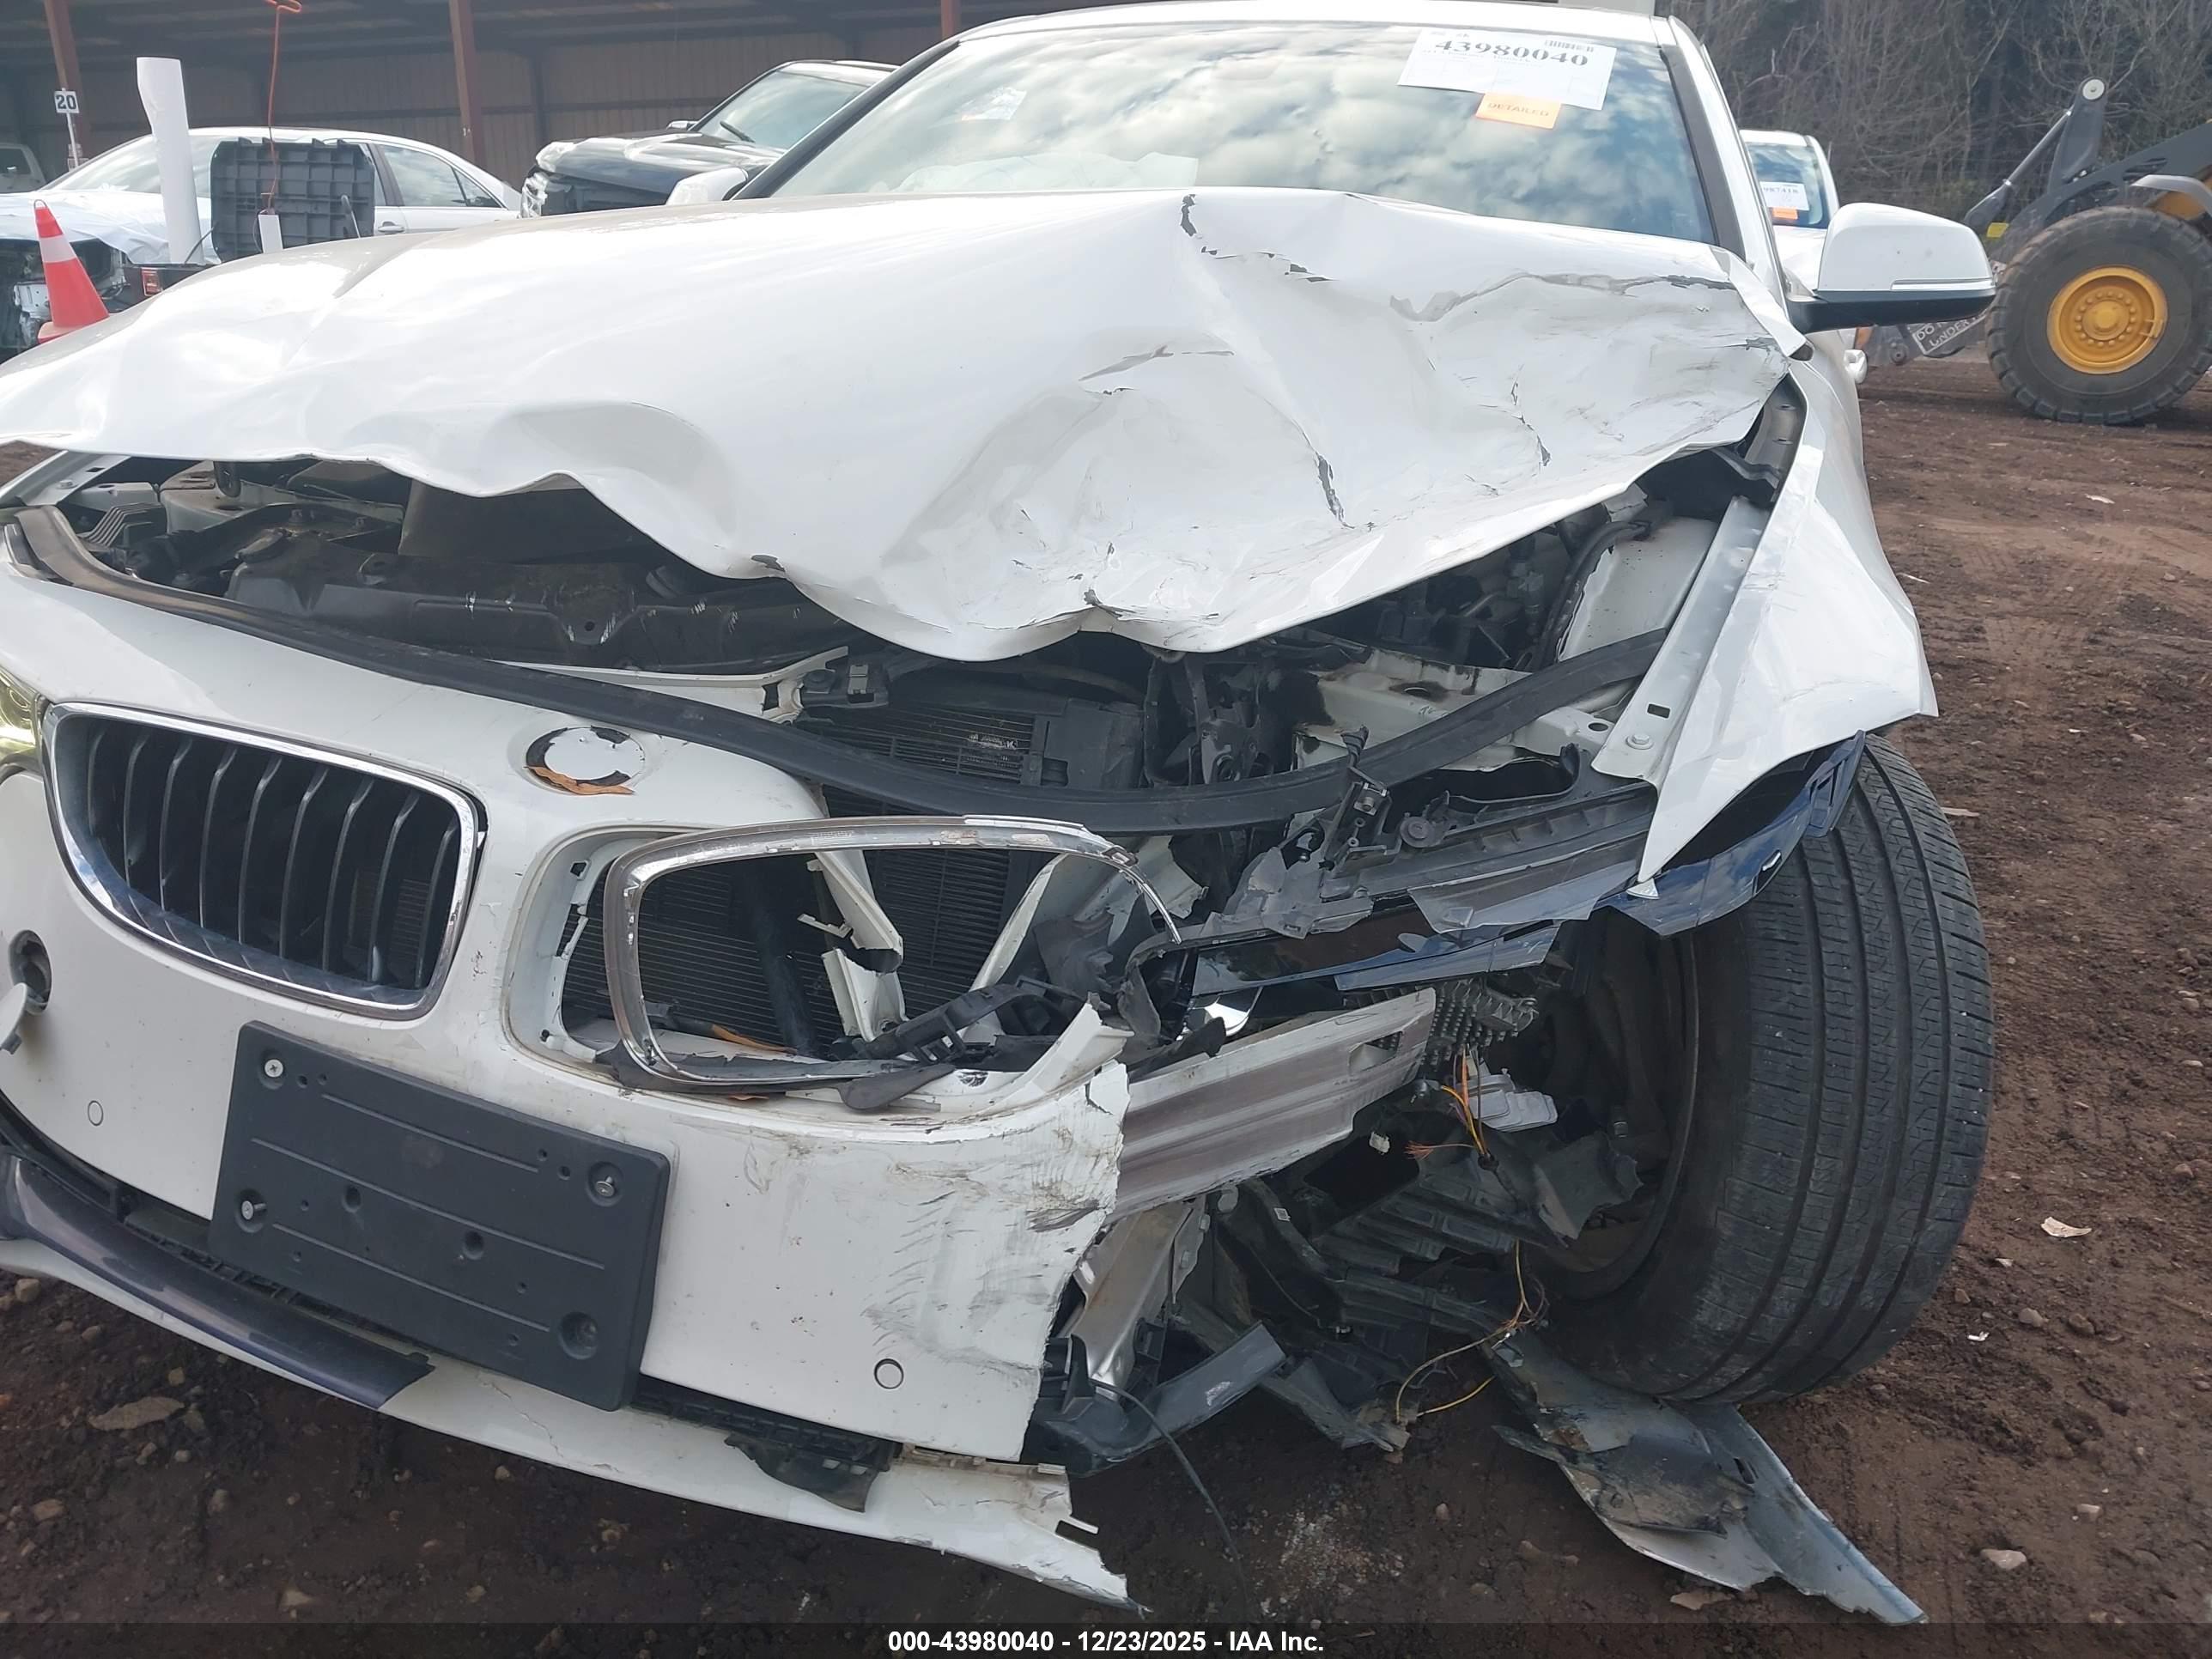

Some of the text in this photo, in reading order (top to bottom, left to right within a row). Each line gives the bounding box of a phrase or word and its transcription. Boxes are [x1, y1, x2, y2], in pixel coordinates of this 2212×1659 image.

[1435, 40, 1589, 67] 43980040
[56, 94, 76, 110] 20
[1486, 101, 1550, 118] DETAILED
[1929, 319, 1971, 348] UNDER
